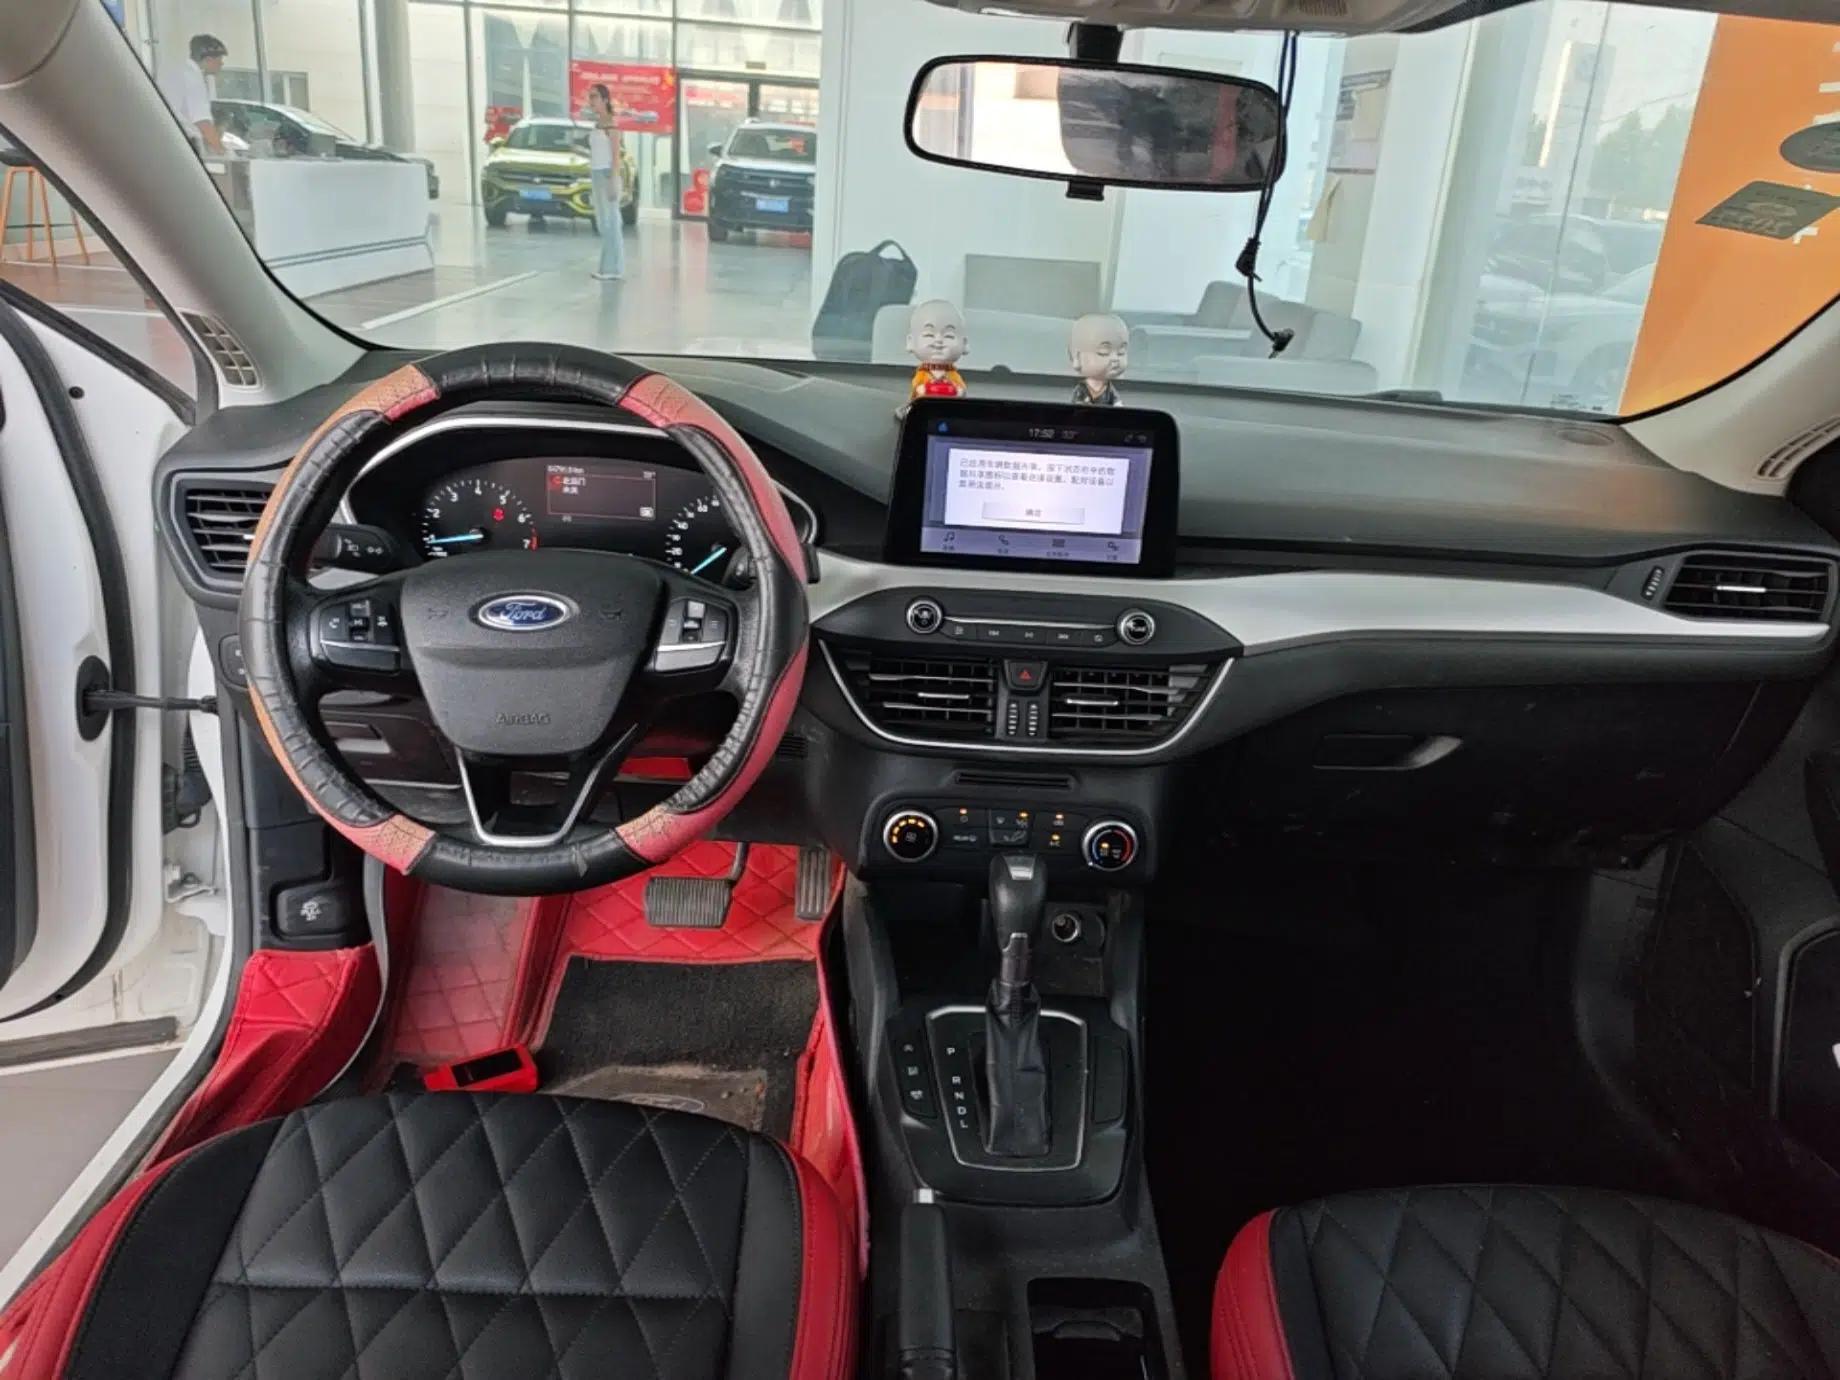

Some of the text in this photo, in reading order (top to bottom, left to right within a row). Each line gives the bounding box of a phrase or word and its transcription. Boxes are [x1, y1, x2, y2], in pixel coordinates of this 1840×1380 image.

[474, 486, 483, 496] 4
[450, 491, 459, 503] 3
[498, 495, 507, 506] 5
[432, 508, 441, 518] 2
[517, 513, 526, 523] 6
[522, 539, 531, 549] 7
[500, 602, 547, 621] Ford
[495, 712, 552, 726] AIRBAG
[946, 1047, 956, 1055] P
[952, 1076, 961, 1084] R
[954, 1092, 965, 1100] N
[957, 1106, 967, 1115] D
[959, 1119, 969, 1129] L
